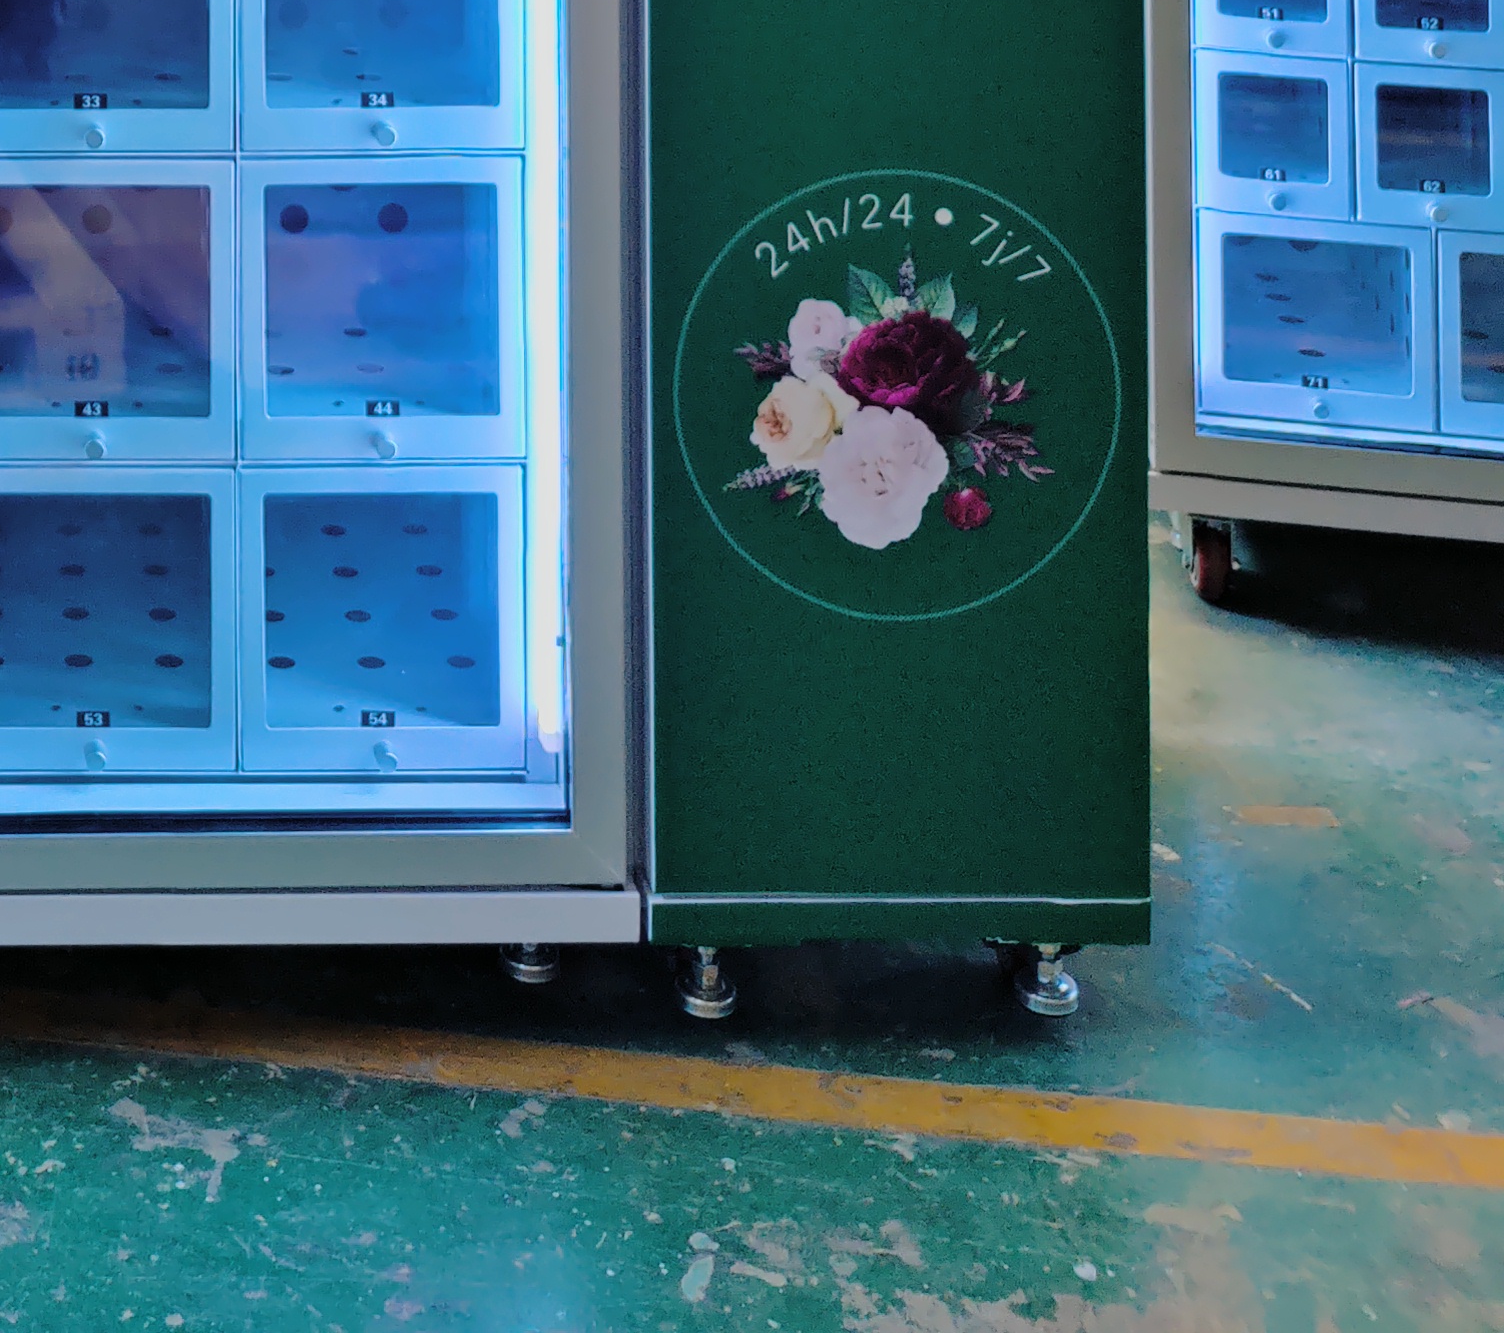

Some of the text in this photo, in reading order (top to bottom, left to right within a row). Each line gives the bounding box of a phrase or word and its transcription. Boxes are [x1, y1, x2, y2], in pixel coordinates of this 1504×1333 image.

[82, 95, 100, 108] 33
[369, 94, 387, 106] 34
[1265, 169, 1279, 180] 61
[1424, 181, 1441, 192] 62
[755, 193, 1052, 282] 24h/24 7j/7
[1307, 377, 1323, 387] 71
[82, 403, 101, 415] 43
[373, 403, 392, 414] 44
[84, 713, 103, 726] 53
[369, 712, 387, 725] 54
